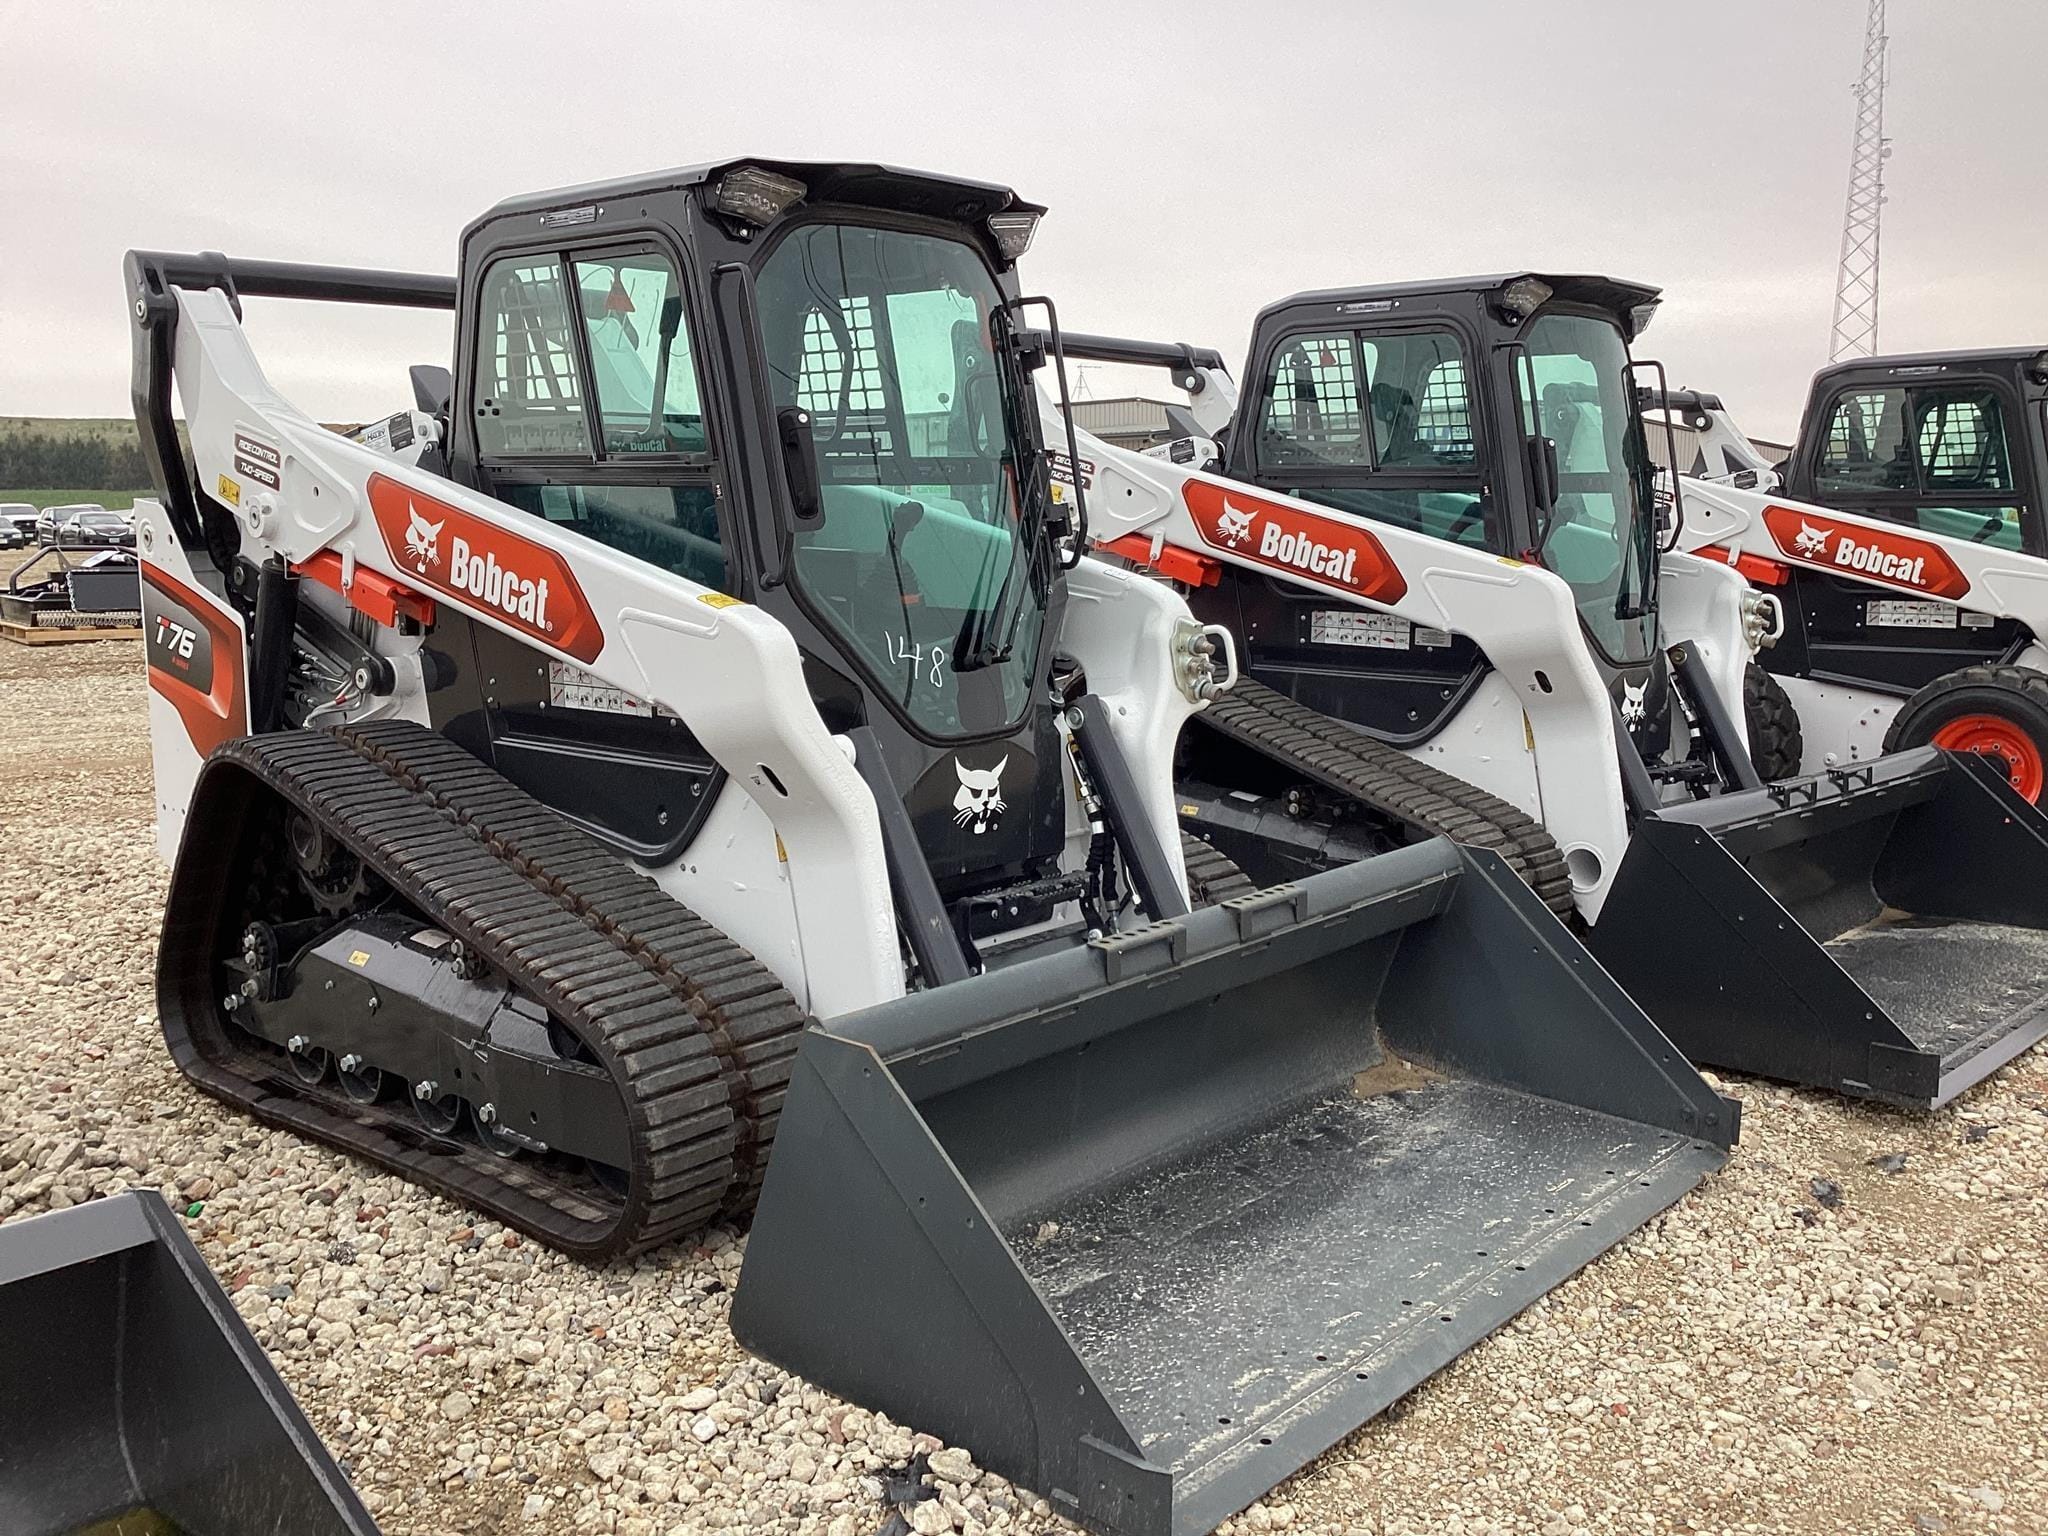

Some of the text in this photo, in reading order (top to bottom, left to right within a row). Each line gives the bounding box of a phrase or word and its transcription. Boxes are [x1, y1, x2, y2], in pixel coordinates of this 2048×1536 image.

[241, 462, 275, 484] TWO-SPEED
[1260, 521, 1356, 583] Bobcat
[1835, 537, 1924, 584] Bobcat
[450, 536, 548, 630] Bobcat
[156, 615, 197, 659] T76
[883, 630, 945, 688] 148
